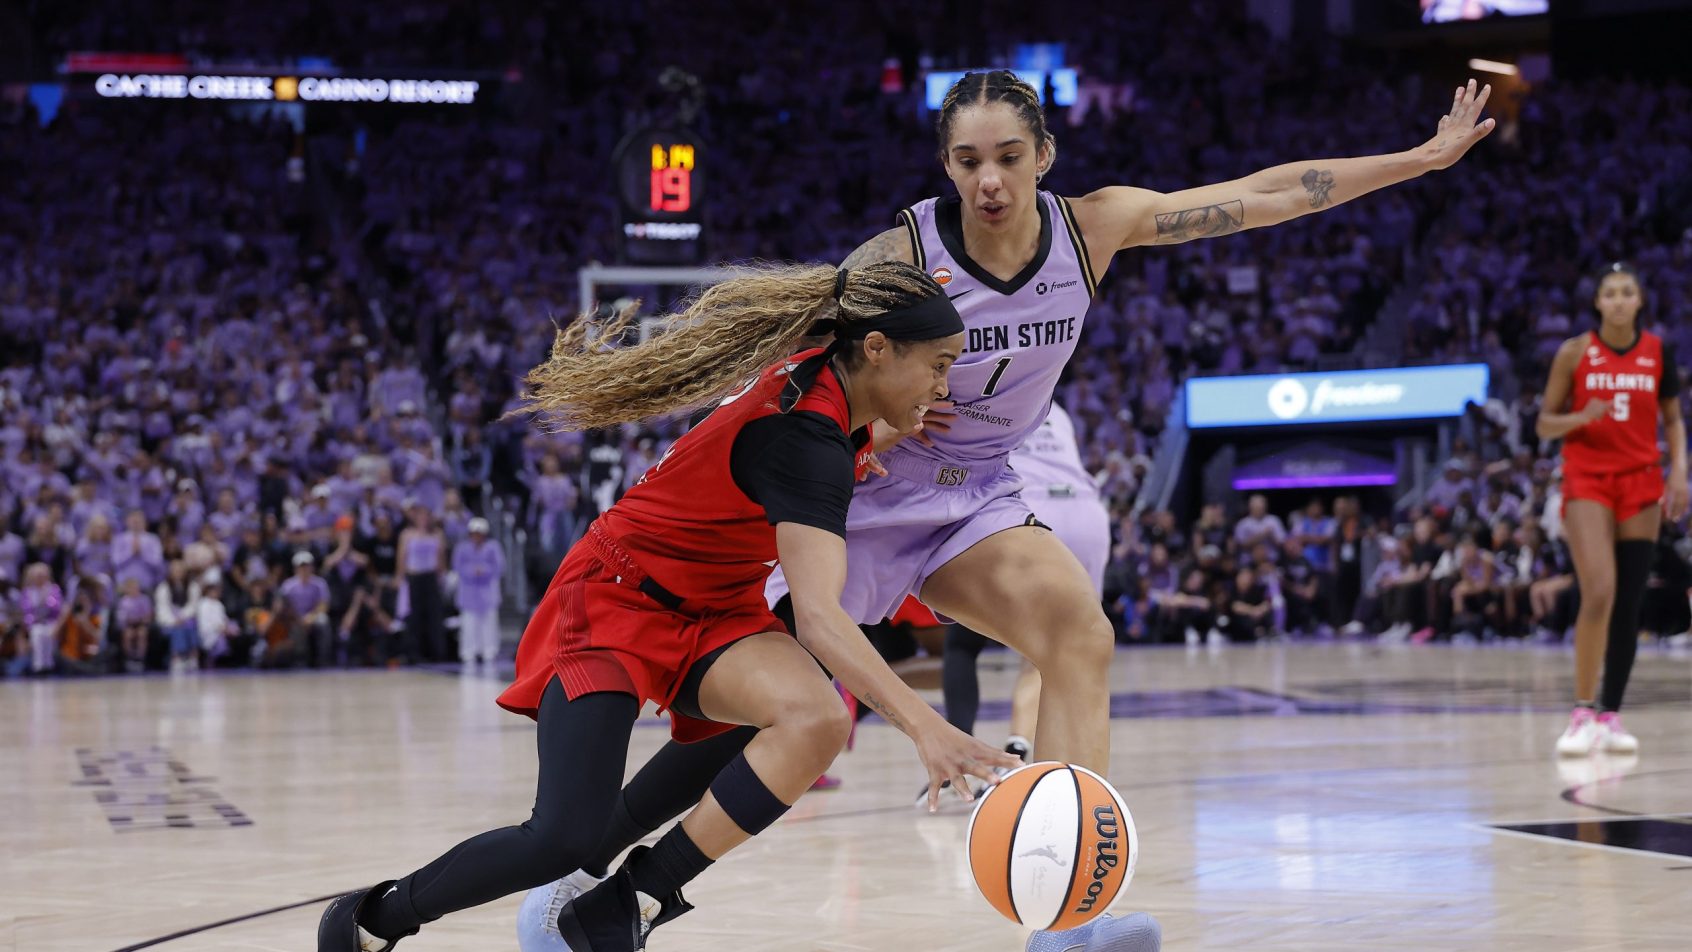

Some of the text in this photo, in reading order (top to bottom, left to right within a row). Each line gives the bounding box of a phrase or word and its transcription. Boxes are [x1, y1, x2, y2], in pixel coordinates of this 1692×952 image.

[298, 77, 389, 101] CASINO
[651, 167, 690, 212] 19
[1050, 280, 1078, 293] freedom
[962, 317, 1076, 353] DEN STATE
[982, 356, 1014, 397] 1
[1586, 373, 1655, 392] ATLANTA
[953, 407, 1013, 427] PERMANENTE
[1613, 392, 1630, 421] 5
[1074, 805, 1119, 914] Wilson
